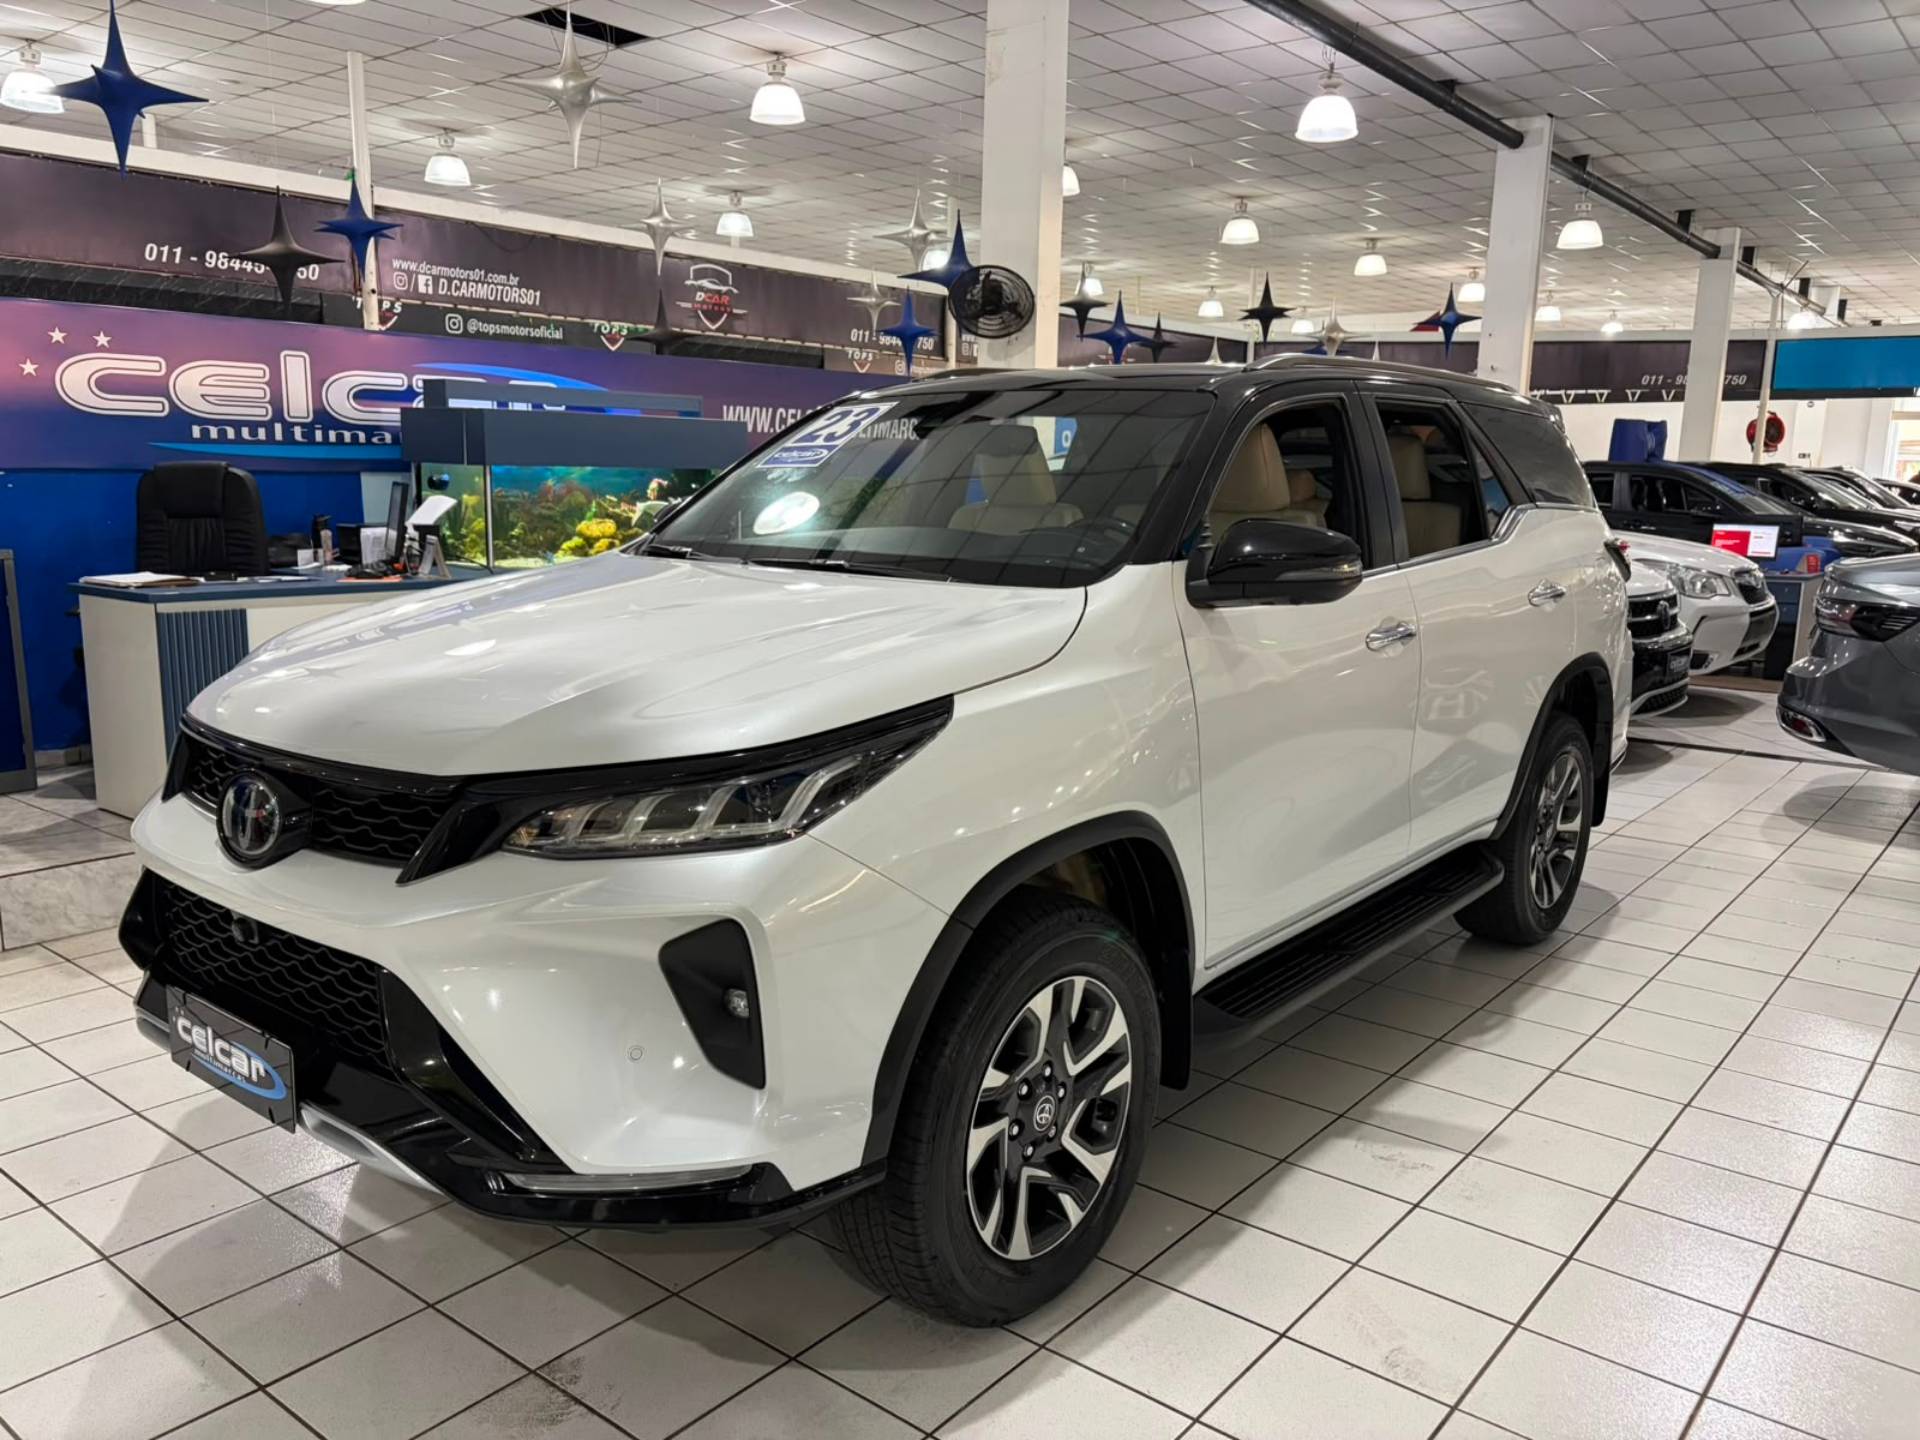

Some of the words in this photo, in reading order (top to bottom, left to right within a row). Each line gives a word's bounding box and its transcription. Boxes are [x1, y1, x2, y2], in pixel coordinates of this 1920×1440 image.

[144, 243, 182, 264] 011
[392, 258, 520, 286] www.dcarmotors01.com.br
[438, 278, 541, 306] D.CARMOTORS01
[467, 318, 563, 341] @topsmotorsoficial
[850, 328, 870, 343] 011
[1641, 374, 1664, 386] 011
[190, 421, 402, 445] multima
[792, 406, 881, 444] 23
[177, 1016, 266, 1082] celcar
